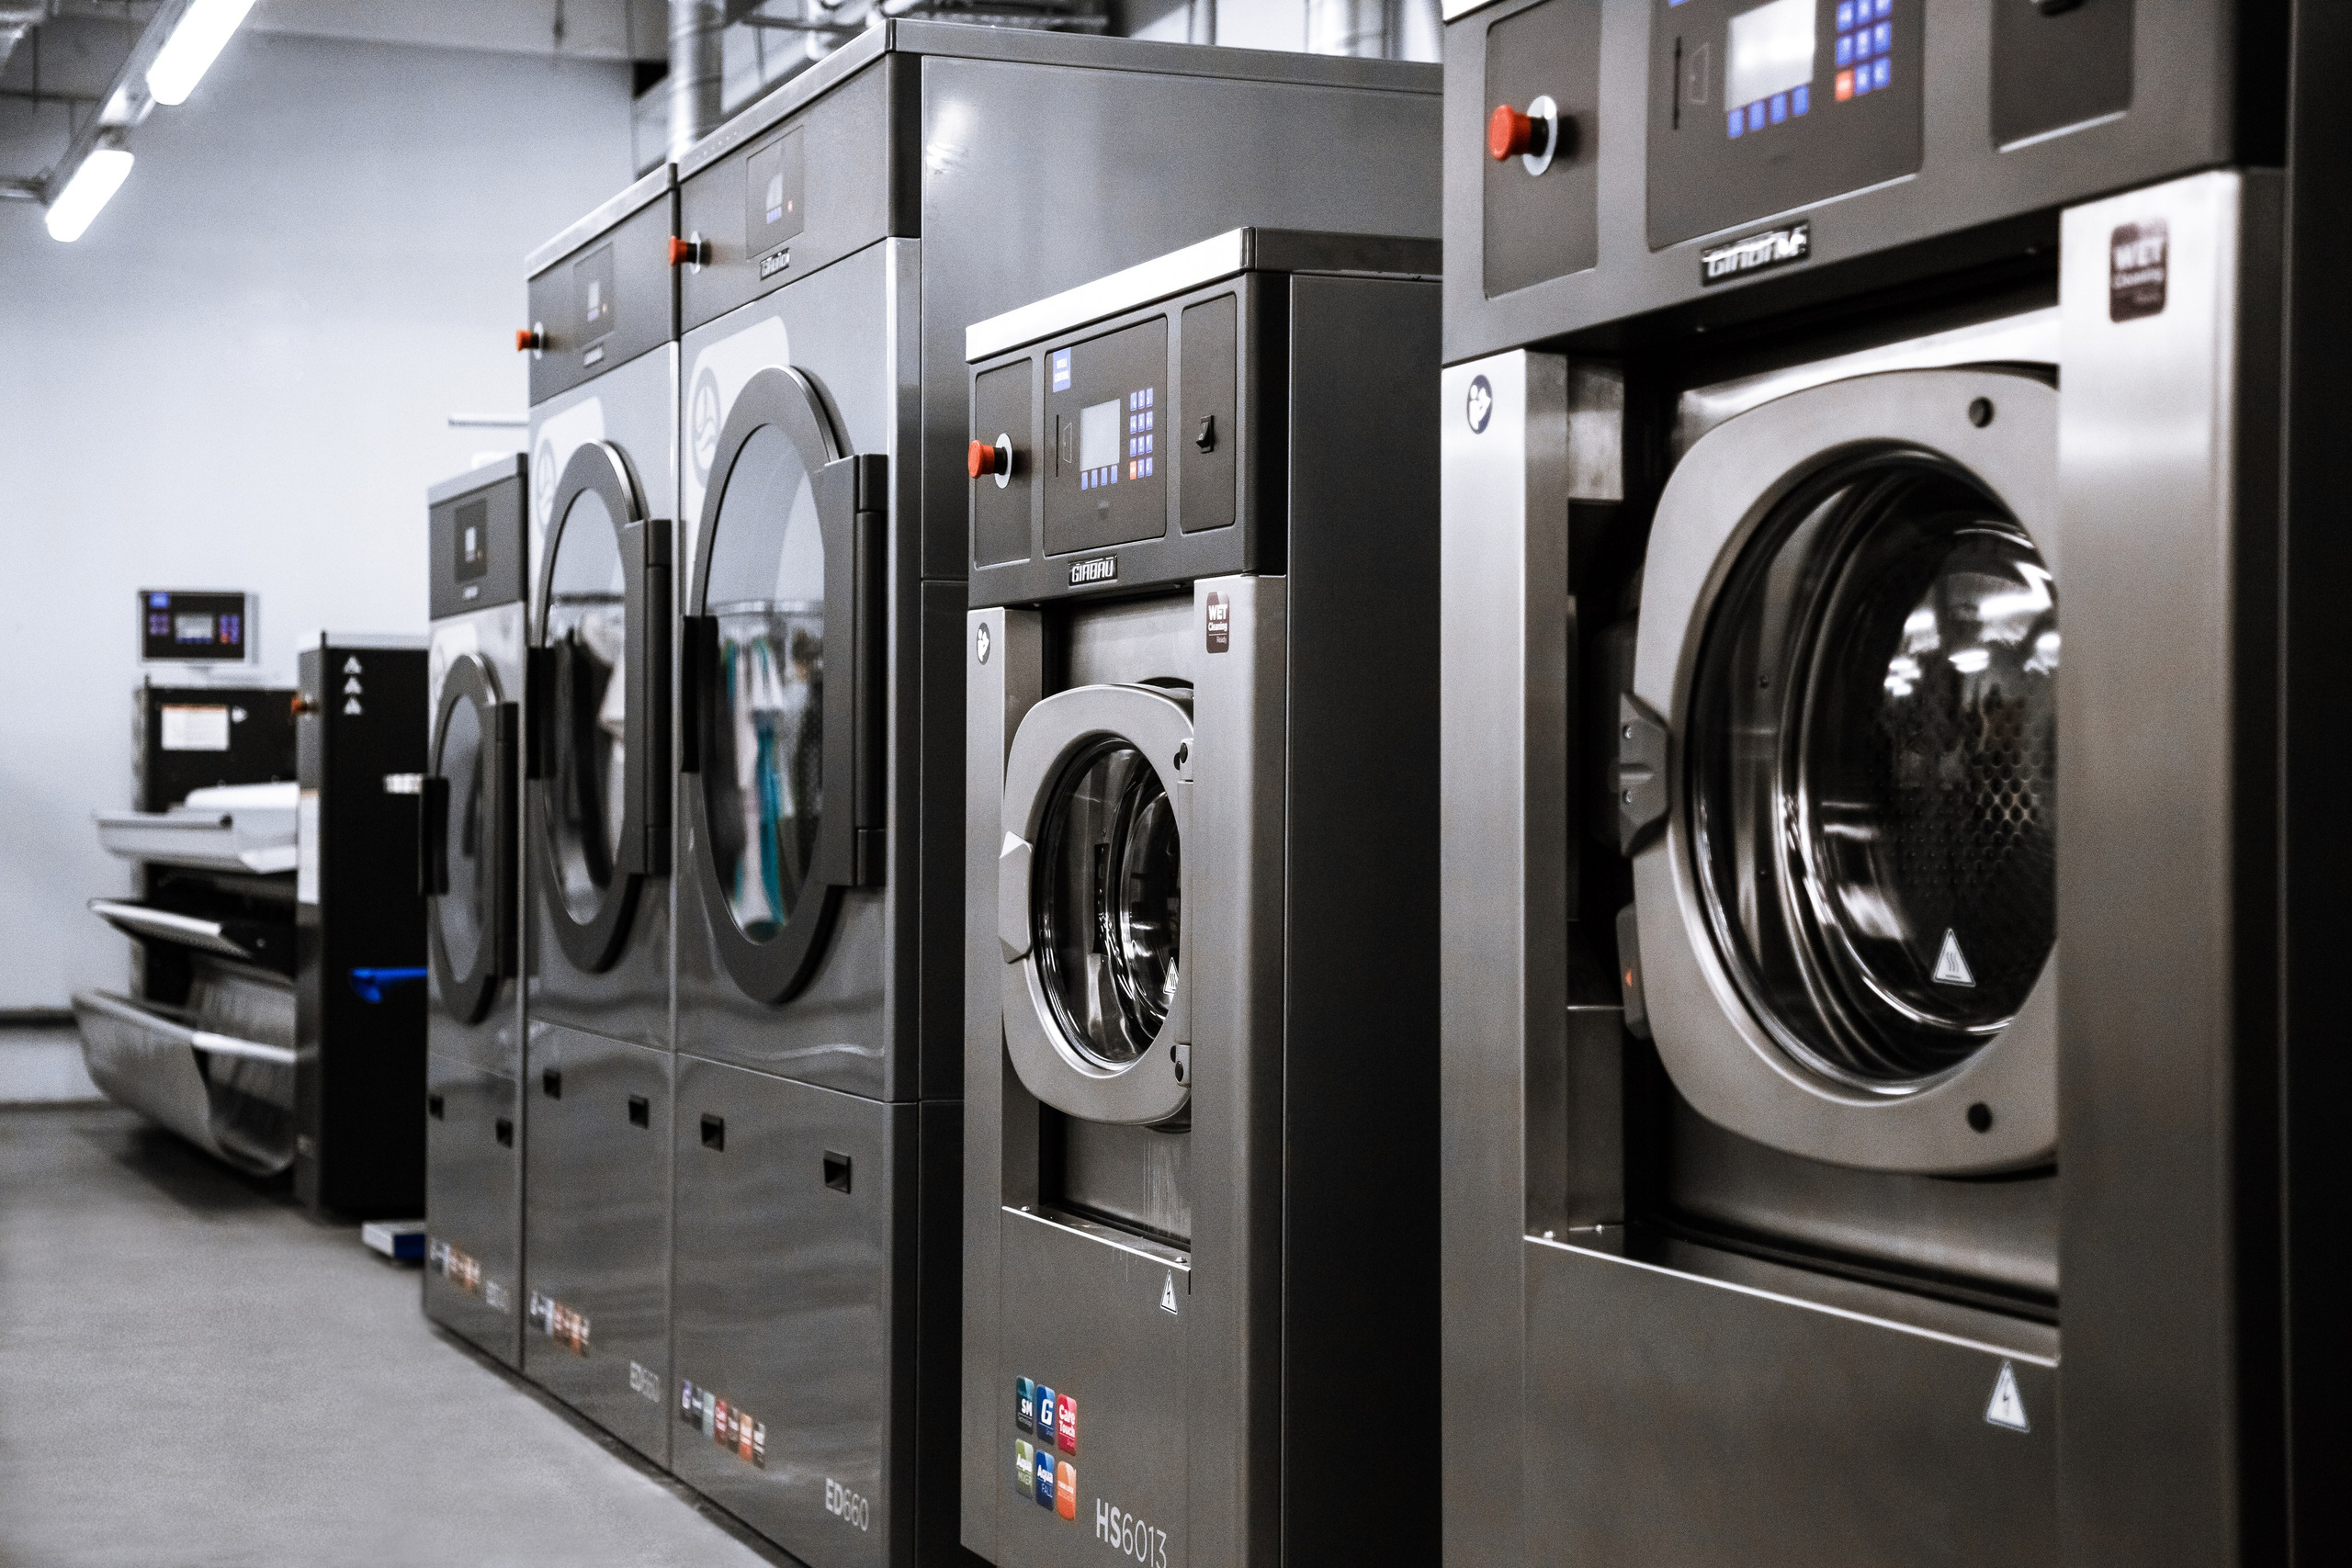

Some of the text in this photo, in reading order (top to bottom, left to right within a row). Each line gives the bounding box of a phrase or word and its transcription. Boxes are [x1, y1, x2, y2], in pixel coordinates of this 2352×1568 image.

[2115, 238, 2163, 270] WET
[1071, 559, 1114, 583] GIRBAU
[1208, 604, 1228, 621] WET
[1208, 621, 1228, 632] Cleaning
[1022, 1398, 1033, 1417] SM
[1041, 1398, 1054, 1426] G
[1058, 1404, 1076, 1426] Care
[1058, 1419, 1076, 1438] Touch
[1016, 1453, 1033, 1473] Aqua
[1037, 1464, 1054, 1484] Aqua
[1041, 1483, 1054, 1499] FALL
[825, 1478, 869, 1532] ED660
[1096, 1497, 1167, 1568] HS6013
